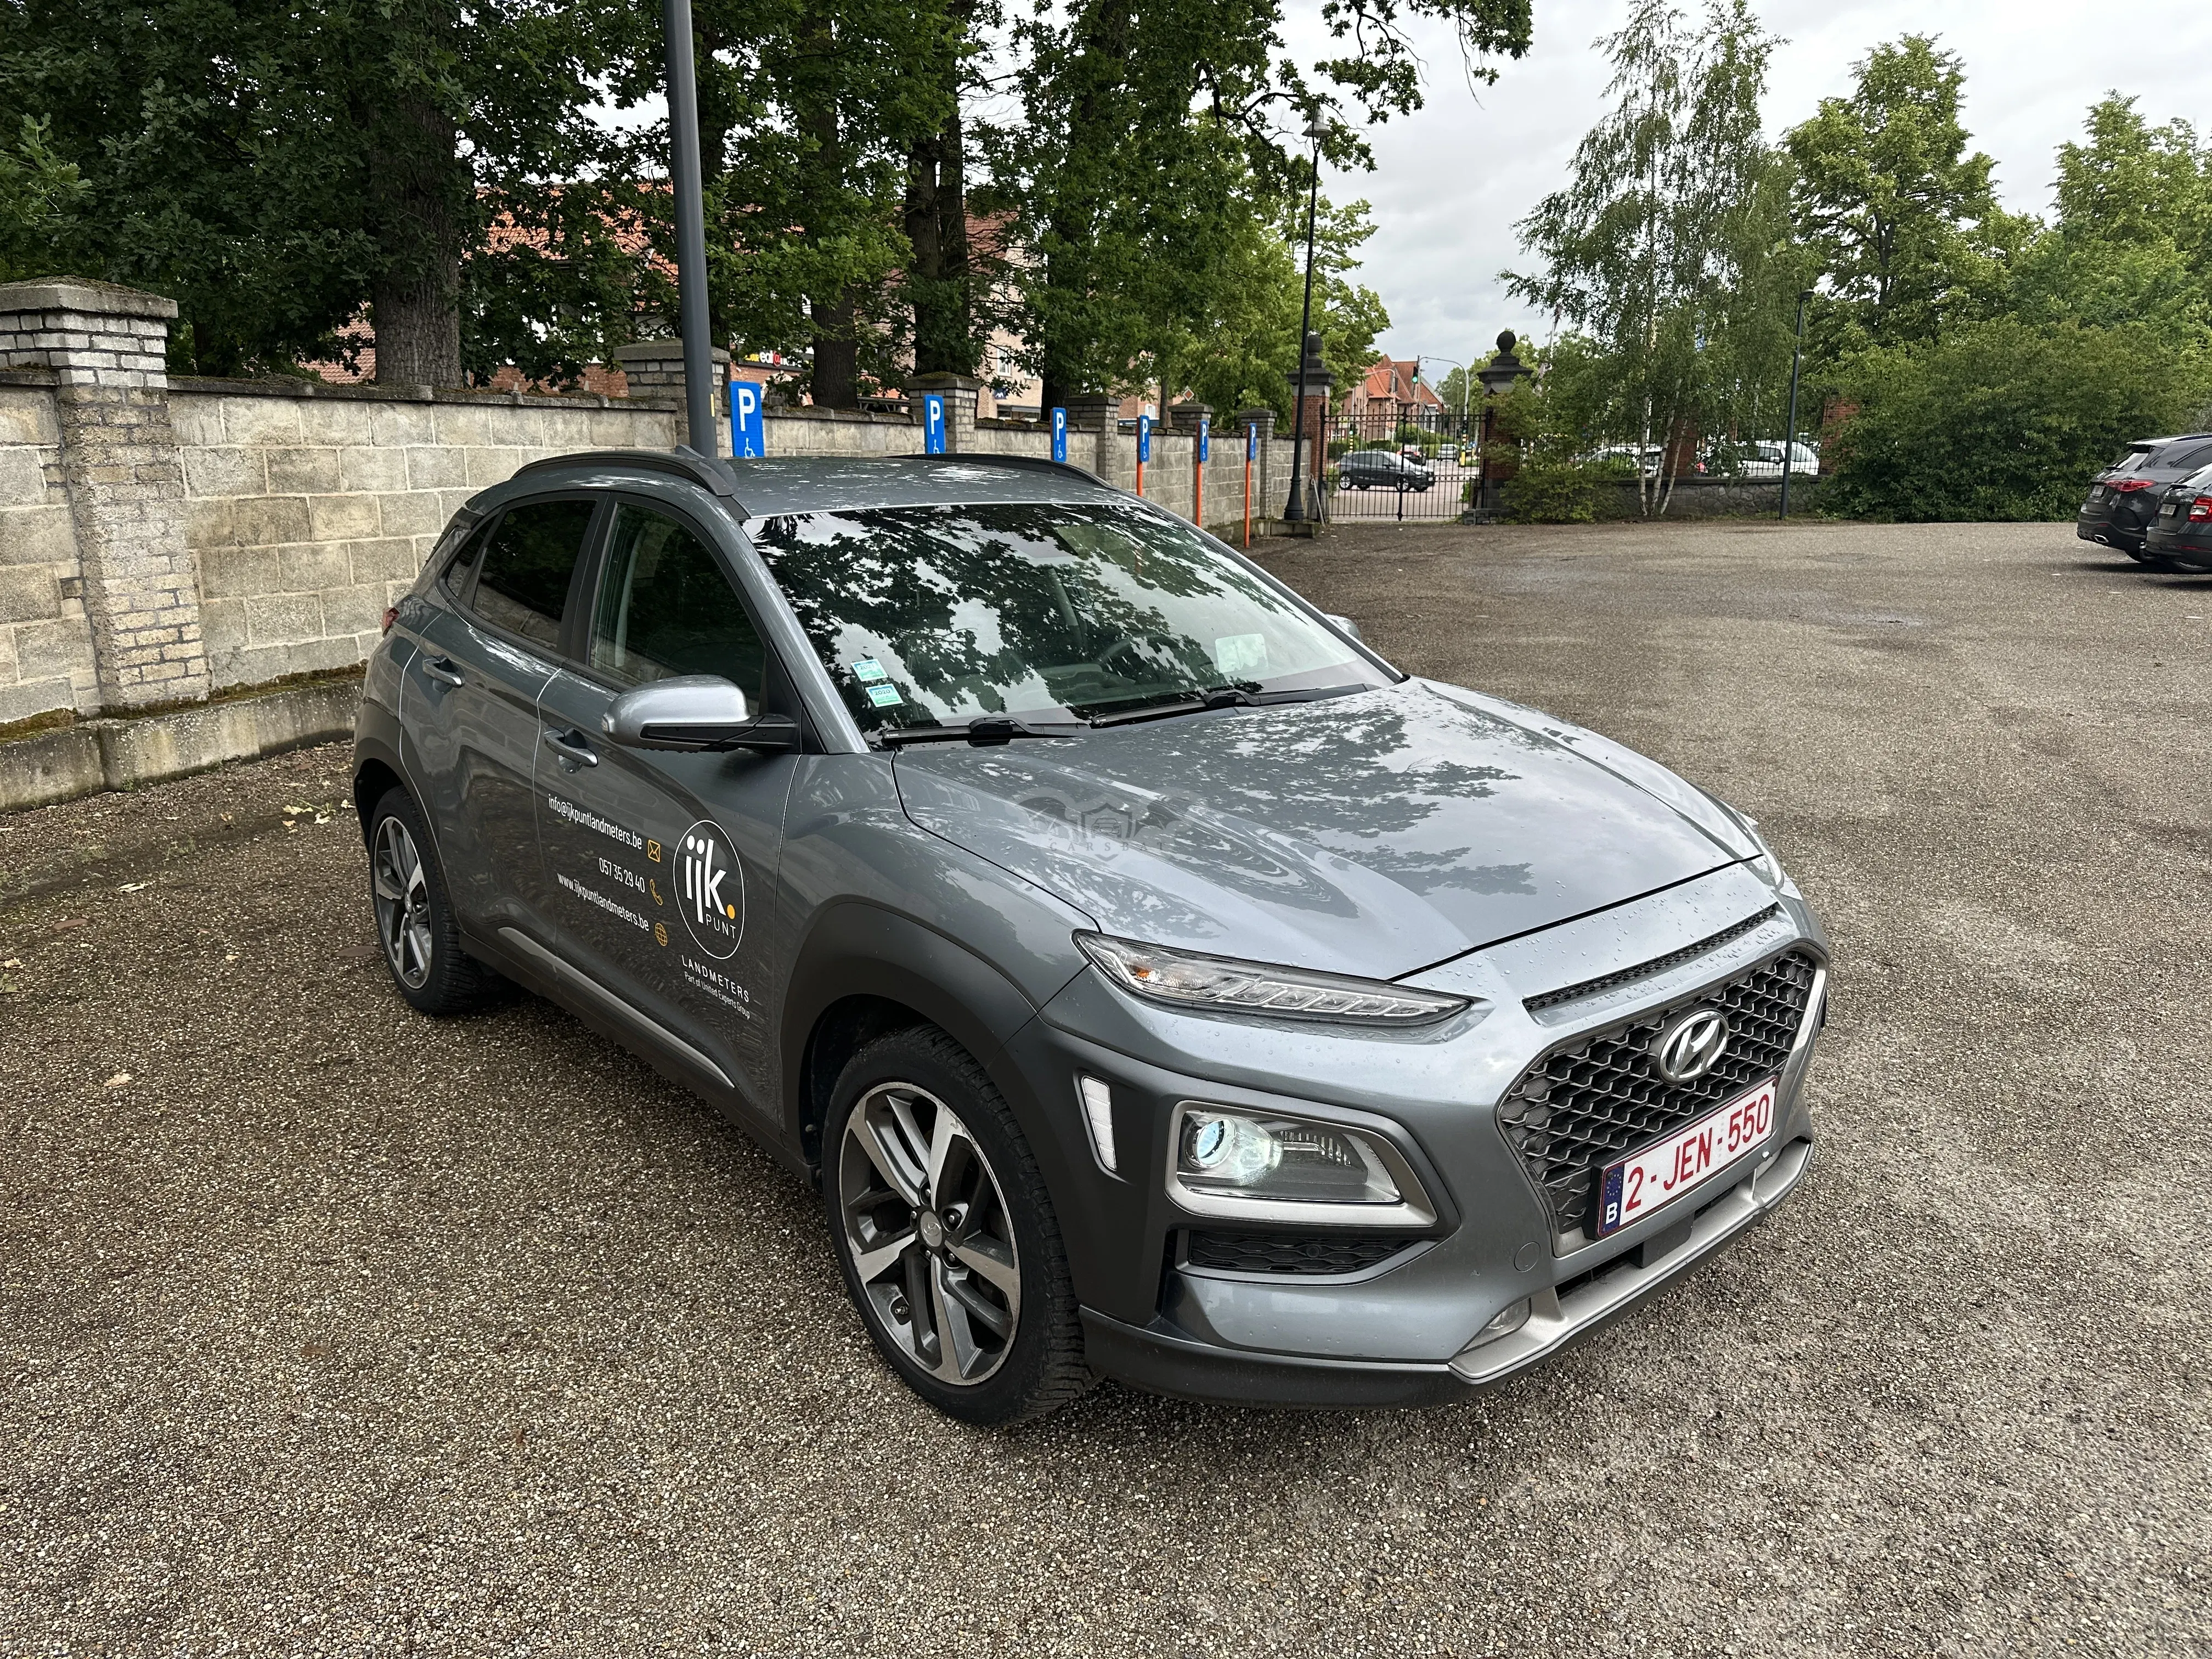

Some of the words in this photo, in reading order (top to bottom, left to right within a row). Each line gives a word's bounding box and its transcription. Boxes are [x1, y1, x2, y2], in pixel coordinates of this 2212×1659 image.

[738, 388, 755, 431] P
[929, 400, 941, 435] P
[1056, 412, 1064, 441] P
[1142, 418, 1149, 443] P
[1201, 422, 1207, 445] P
[1251, 425, 1256, 445] P
[548, 793, 642, 850] info@ijkpuntlandmeters.be
[599, 857, 612, 877] 057
[613, 864, 623, 882] 35
[624, 869, 634, 887] 29
[635, 874, 645, 893] 40
[557, 872, 650, 932] www.ijkpuntlandmeters.be
[706, 913, 737, 939] PUNT
[681, 955, 749, 1003] LANDMETERS
[684, 971, 695, 985] Part
[696, 978, 701, 988] of
[701, 980, 718, 997] United
[718, 990, 737, 1009] Experts
[737, 1001, 751, 1020] Group
[1625, 1093, 1770, 1212] 2-JEN-550
[1605, 1201, 1618, 1225] B
